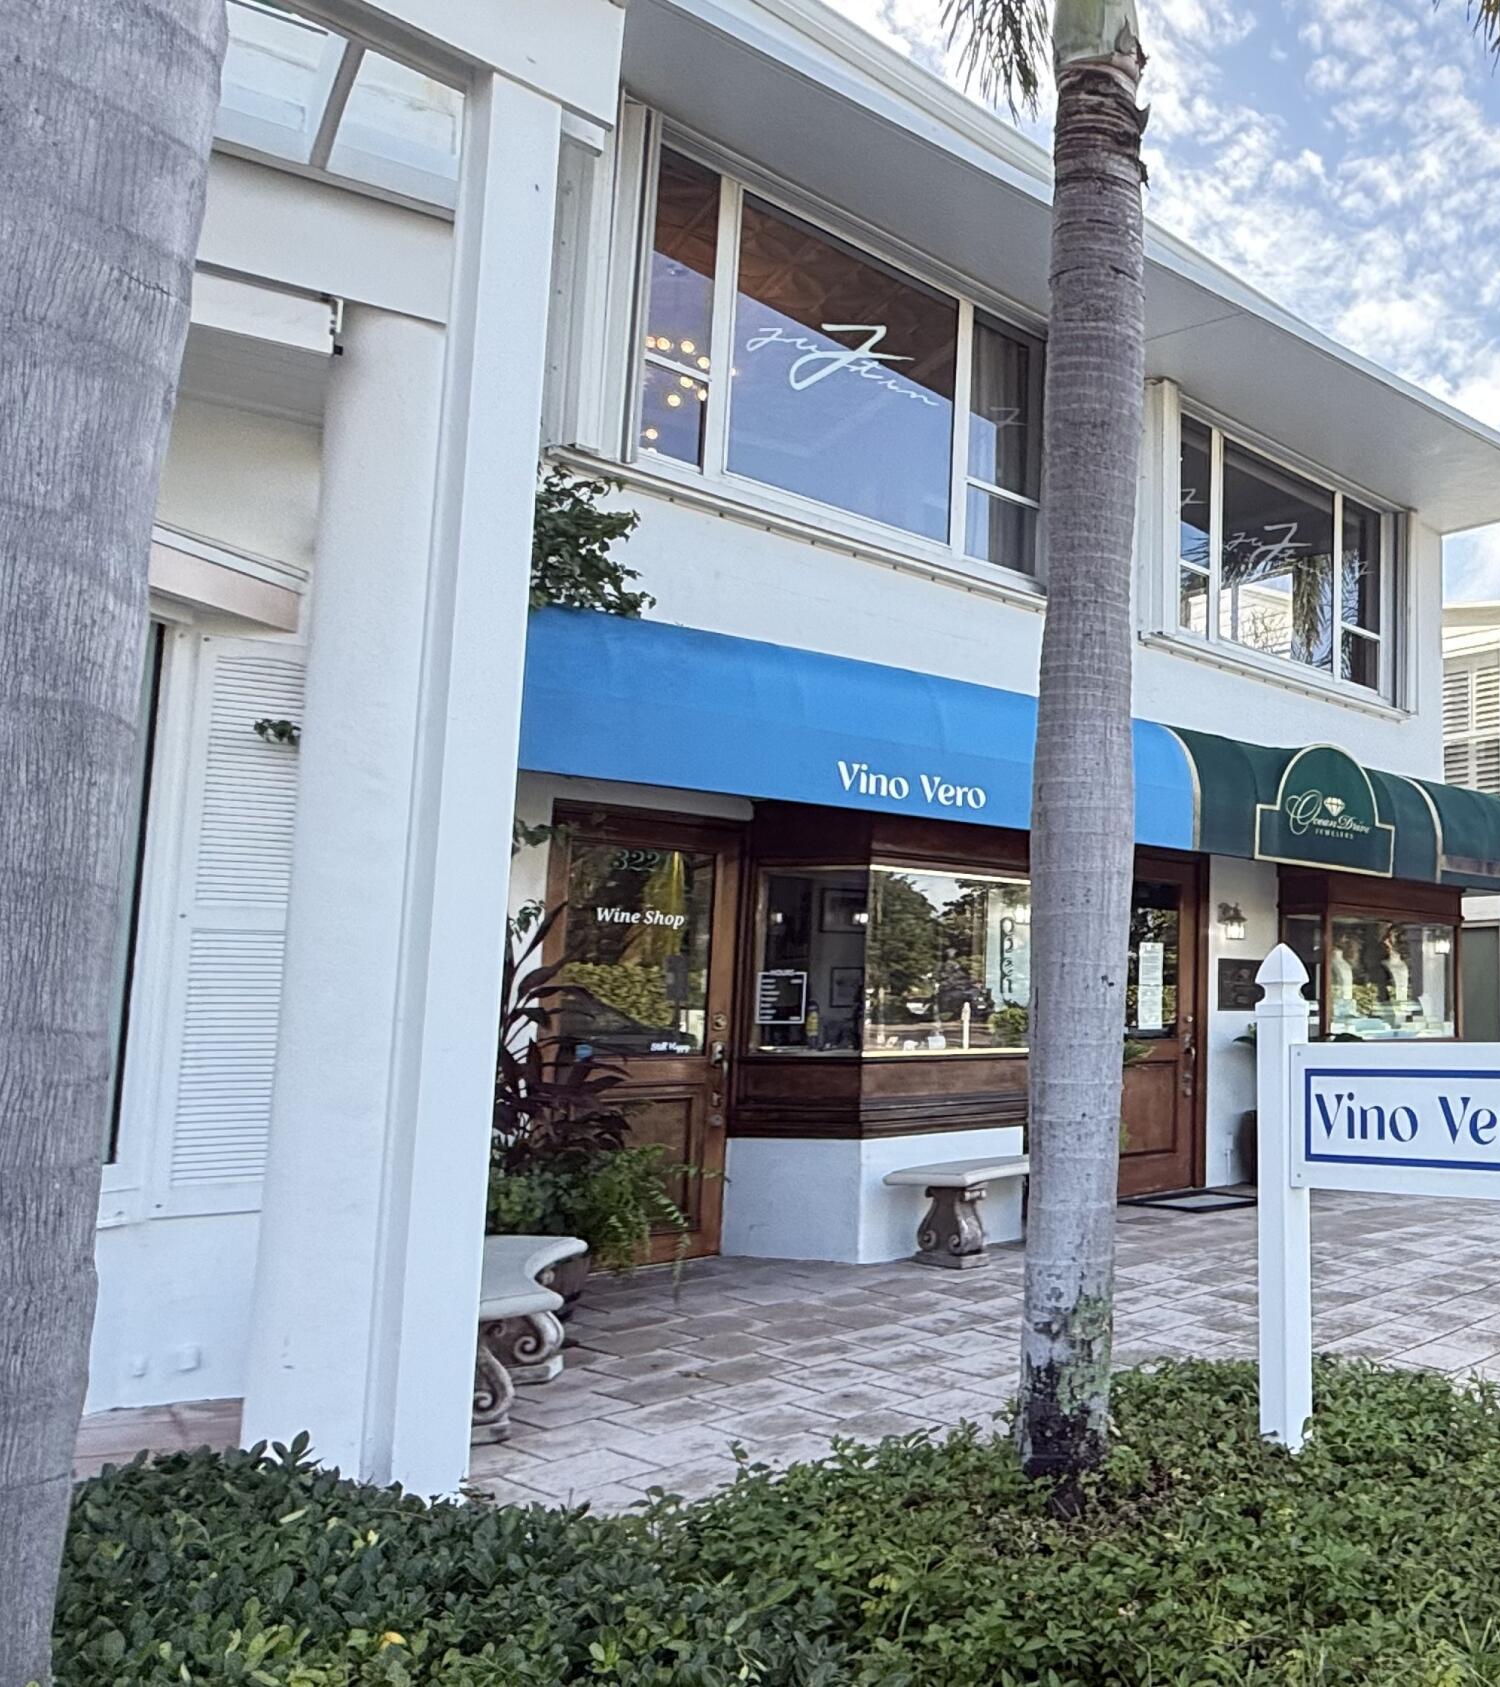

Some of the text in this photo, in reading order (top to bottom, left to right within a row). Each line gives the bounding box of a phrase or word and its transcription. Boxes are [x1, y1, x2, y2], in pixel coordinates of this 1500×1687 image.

[837, 760, 987, 809] Vino Vero
[1285, 788, 1370, 836] Ocean Drive
[612, 850, 660, 872] 322
[596, 907, 685, 930] Wine Shop
[1314, 1092, 1419, 1143] Vino
